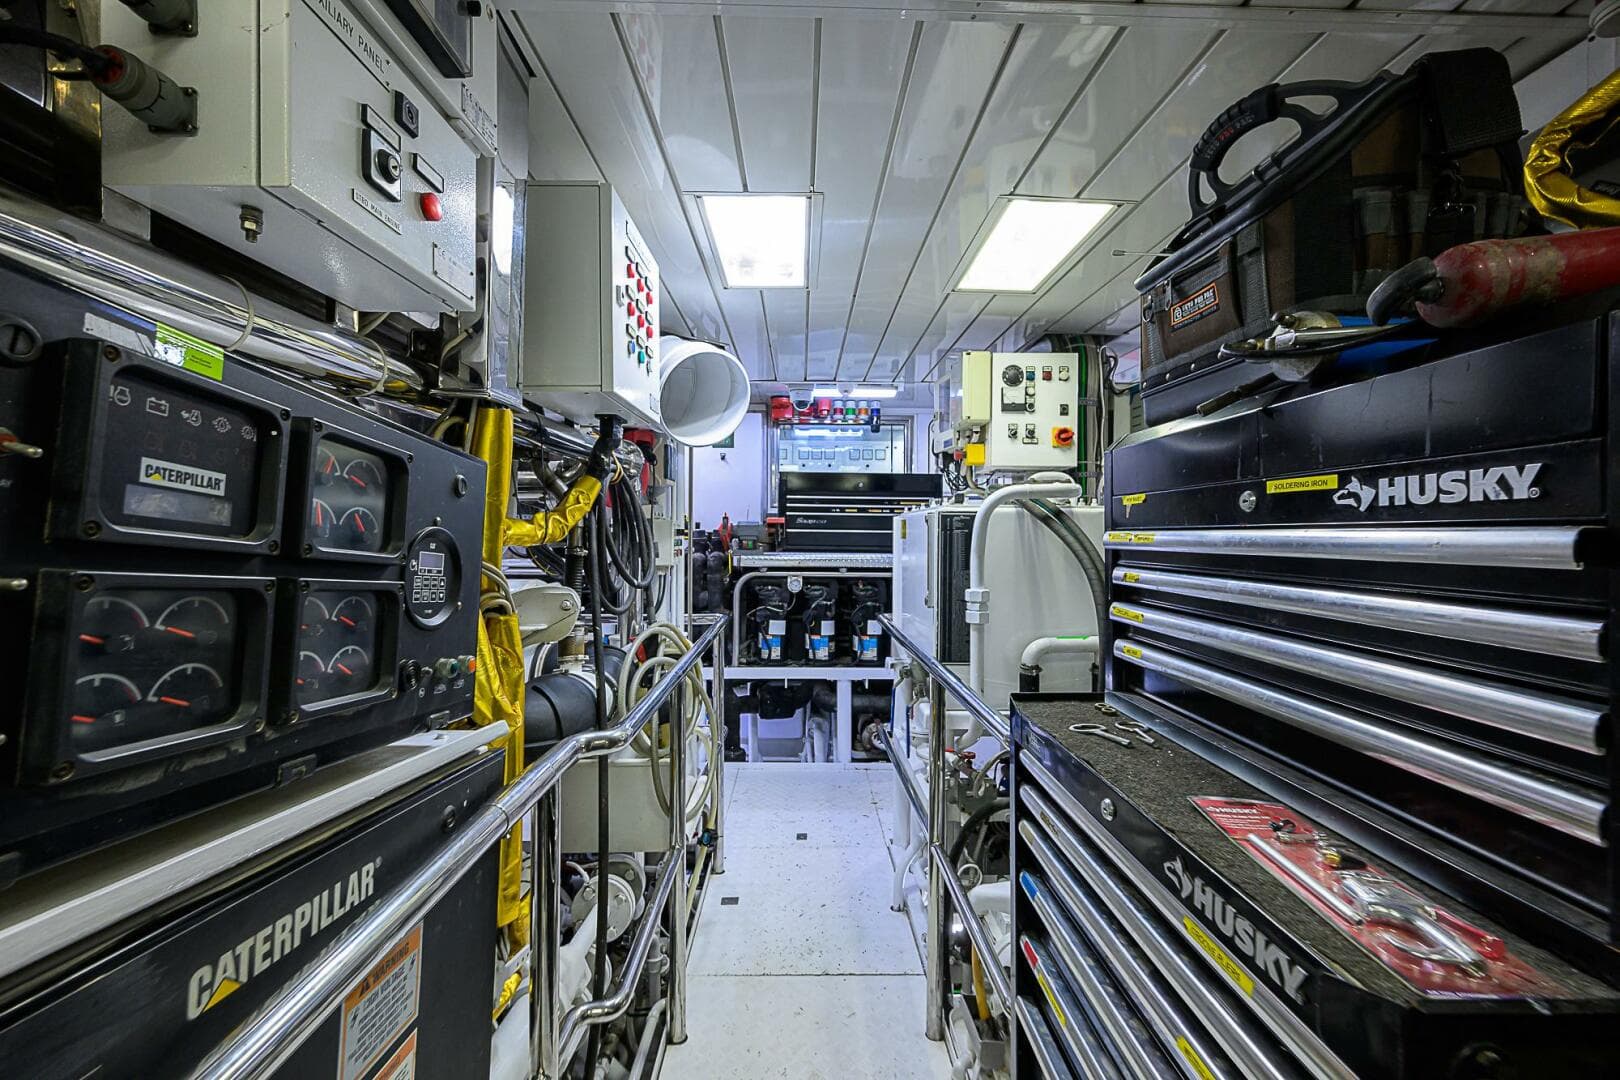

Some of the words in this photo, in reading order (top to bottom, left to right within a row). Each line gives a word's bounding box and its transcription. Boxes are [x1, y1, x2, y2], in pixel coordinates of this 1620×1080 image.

[358, 35, 385, 74] PANEL
[144, 463, 223, 491] CATERPILLAR
[1273, 480, 1310, 490] SOLDERING
[1310, 479, 1329, 487] IRON
[1378, 462, 1543, 507] HUSKY
[186, 861, 376, 1021] CATERPILLAR
[1193, 876, 1309, 1006] HUSKY
[373, 942, 410, 985] WARNING
